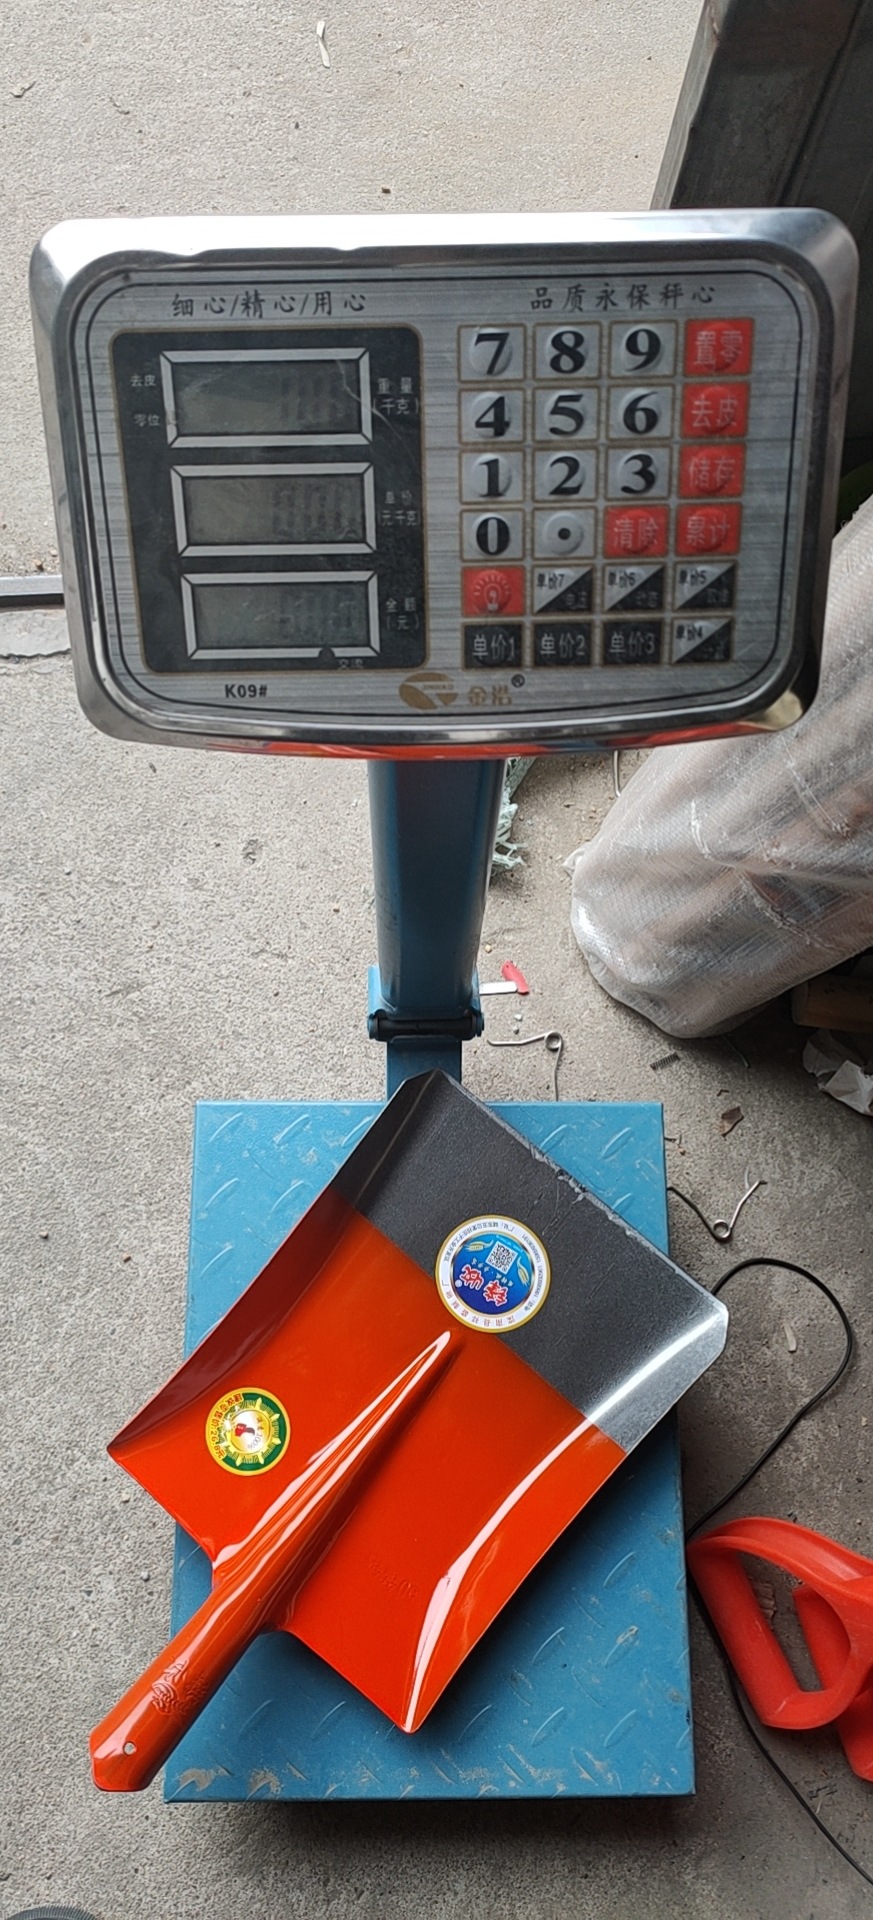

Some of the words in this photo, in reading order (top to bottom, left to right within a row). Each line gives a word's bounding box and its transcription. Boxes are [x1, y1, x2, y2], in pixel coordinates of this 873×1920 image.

[171, 291, 368, 318] 细心/精心/用心
[530, 283, 717, 311] 品质永保秤心
[474, 332, 511, 376] 7
[549, 329, 585, 374] 8
[625, 328, 662, 372] 9
[692, 329, 744, 366] 置零
[130, 374, 157, 388] 去皮
[376, 376, 414, 395] 重量
[133, 413, 161, 427] 零位
[474, 395, 511, 438] 4
[549, 393, 585, 436] 5
[622, 390, 659, 435] 6
[690, 396, 740, 429] 去皮
[479, 456, 504, 499] 1
[548, 454, 584, 497] 2
[620, 452, 657, 495] 3
[688, 456, 736, 488] 储存
[475, 515, 511, 556] 0
[613, 518, 661, 548] 清除
[684, 515, 731, 546] 累计
[472, 633, 517, 660] 单价1
[540, 632, 586, 658] 单价2
[609, 630, 656, 656] 单价3
[224, 683, 269, 699] K09#
